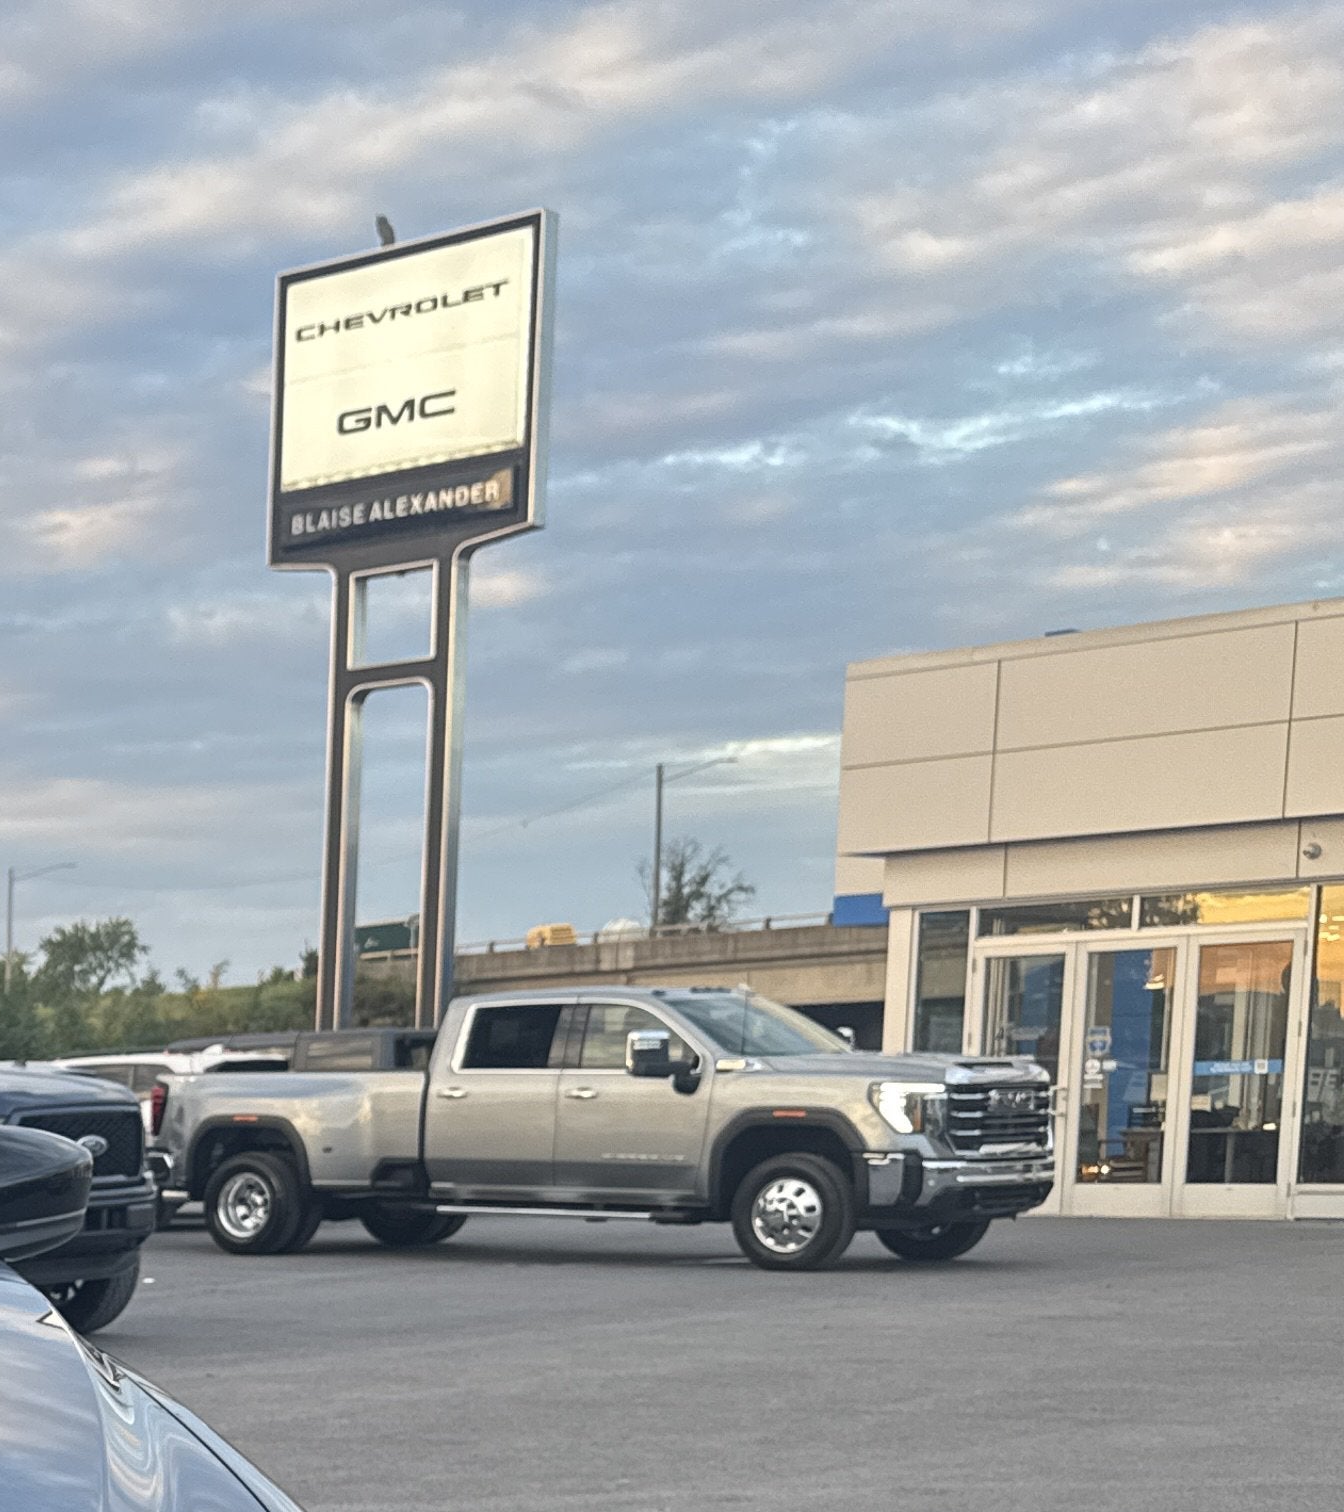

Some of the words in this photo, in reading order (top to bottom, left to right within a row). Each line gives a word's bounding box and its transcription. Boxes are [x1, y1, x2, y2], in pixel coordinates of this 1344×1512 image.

[295, 280, 508, 342] CHEVROLET
[337, 390, 456, 435] GMC
[291, 504, 366, 536] BLAISE
[369, 482, 499, 522] ALEXANDER
